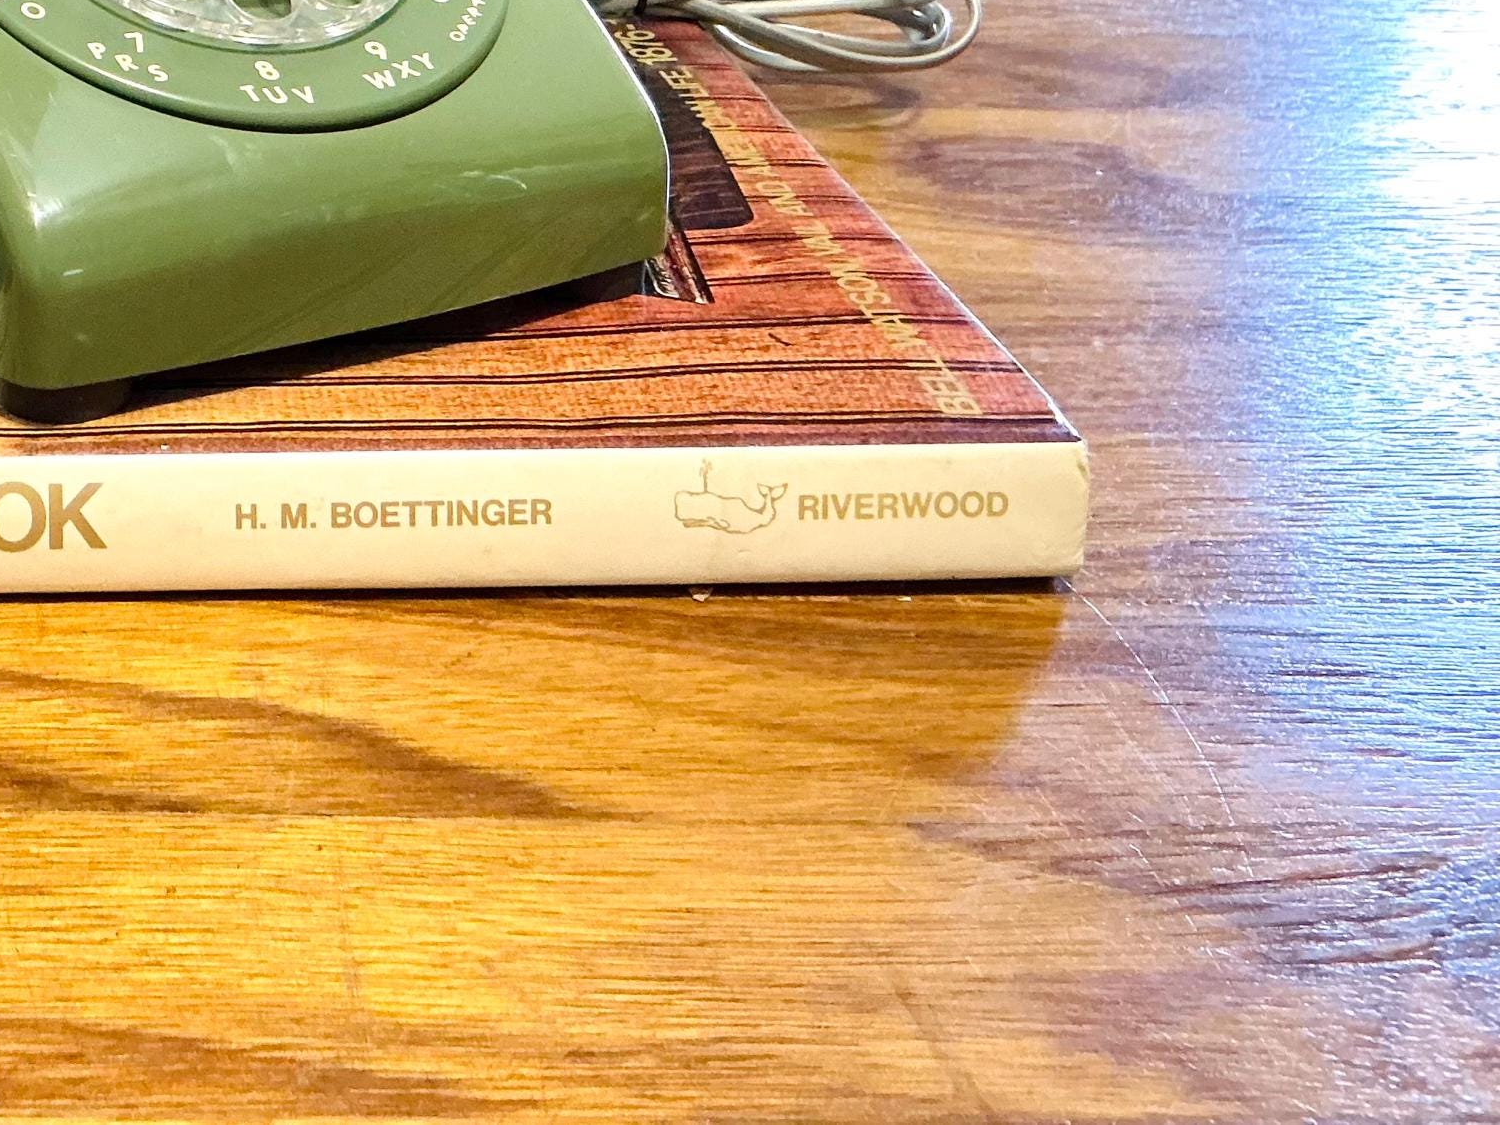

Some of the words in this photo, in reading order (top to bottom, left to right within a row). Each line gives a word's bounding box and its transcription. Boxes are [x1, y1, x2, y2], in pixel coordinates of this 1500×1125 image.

[124, 31, 144, 53] 7
[363, 40, 388, 60] 9
[87, 41, 169, 82] PRS
[254, 60, 280, 81] 8
[362, 52, 435, 89] WXY
[239, 84, 315, 104] TUV
[658, 66, 709, 97] LIFE
[755, 181, 814, 216] AND
[235, 504, 267, 531] H.
[280, 503, 317, 530] M.
[330, 498, 553, 529] BOETTINGER
[797, 491, 1010, 521] RIVERWOOD
